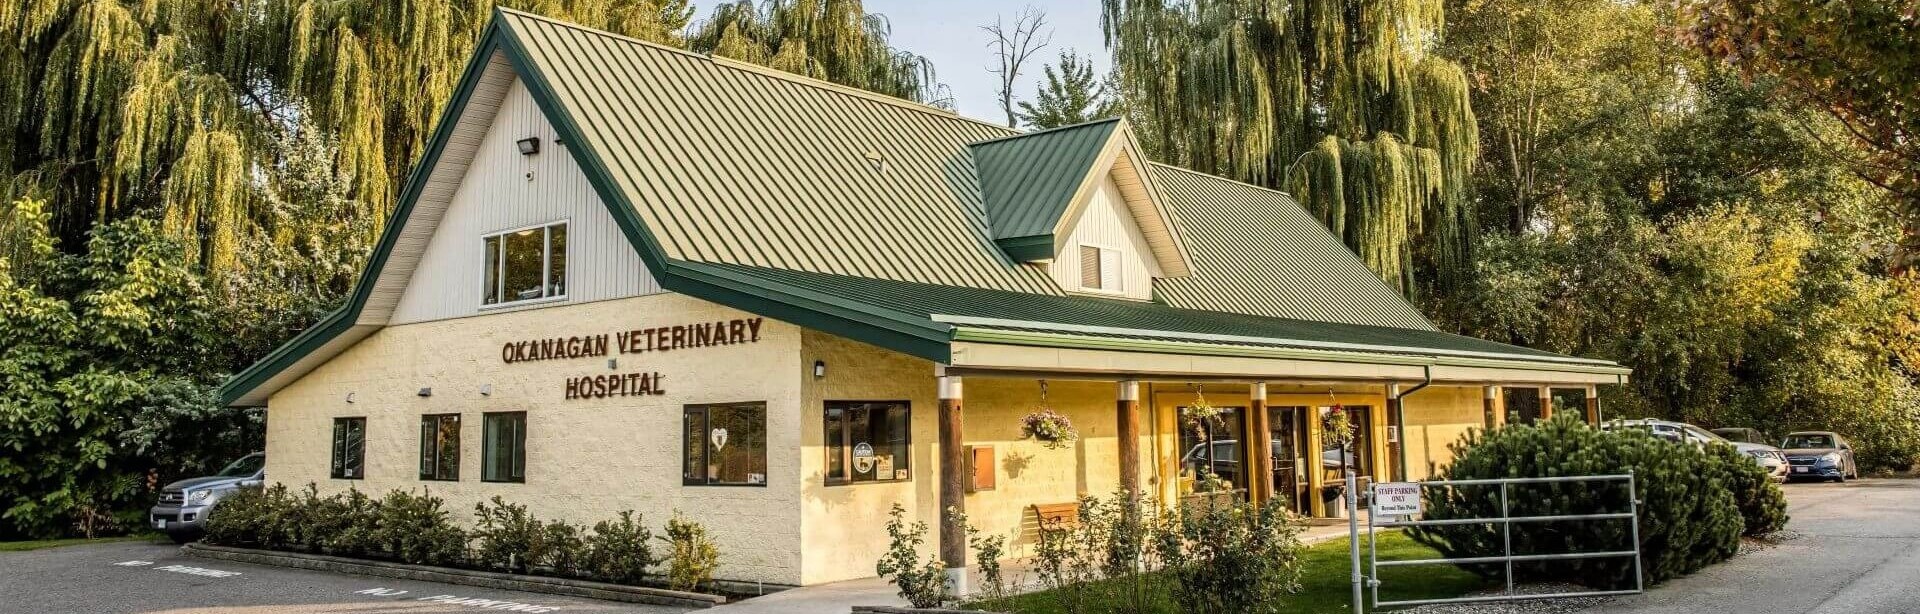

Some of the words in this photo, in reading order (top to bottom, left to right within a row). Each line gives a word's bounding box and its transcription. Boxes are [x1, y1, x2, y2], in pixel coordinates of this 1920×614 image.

[502, 334, 609, 364] OKANAGAN
[616, 318, 762, 354] VETERINARY
[565, 371, 666, 400] HOSPITAL
